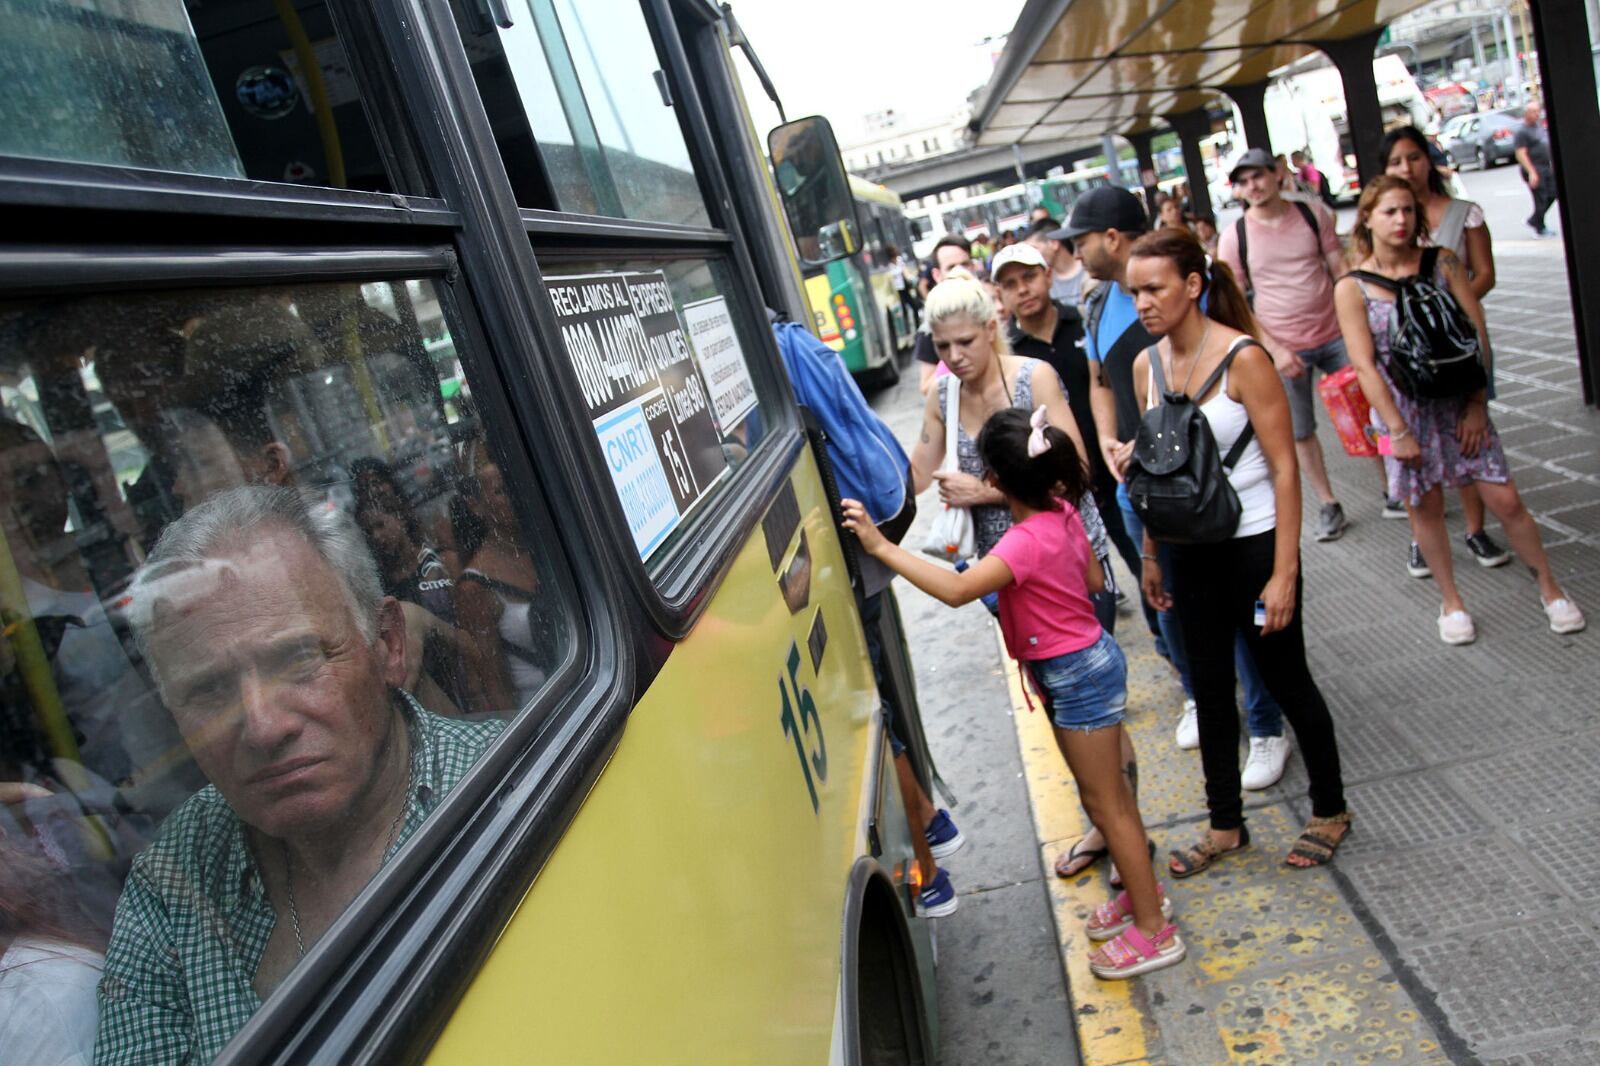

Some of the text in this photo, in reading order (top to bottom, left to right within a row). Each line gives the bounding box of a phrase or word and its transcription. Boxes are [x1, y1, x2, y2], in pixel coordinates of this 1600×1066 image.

[549, 282, 630, 317] RECLAMOS AL
[629, 281, 673, 318] EXPRESO
[561, 313, 656, 410] 0800-4440273
[649, 328, 689, 371] QUILMES
[645, 398, 668, 421] COCHE
[684, 373, 705, 413] 98
[606, 423, 649, 473] CNRT
[661, 429, 690, 499] 15
[779, 639, 828, 816] 15
